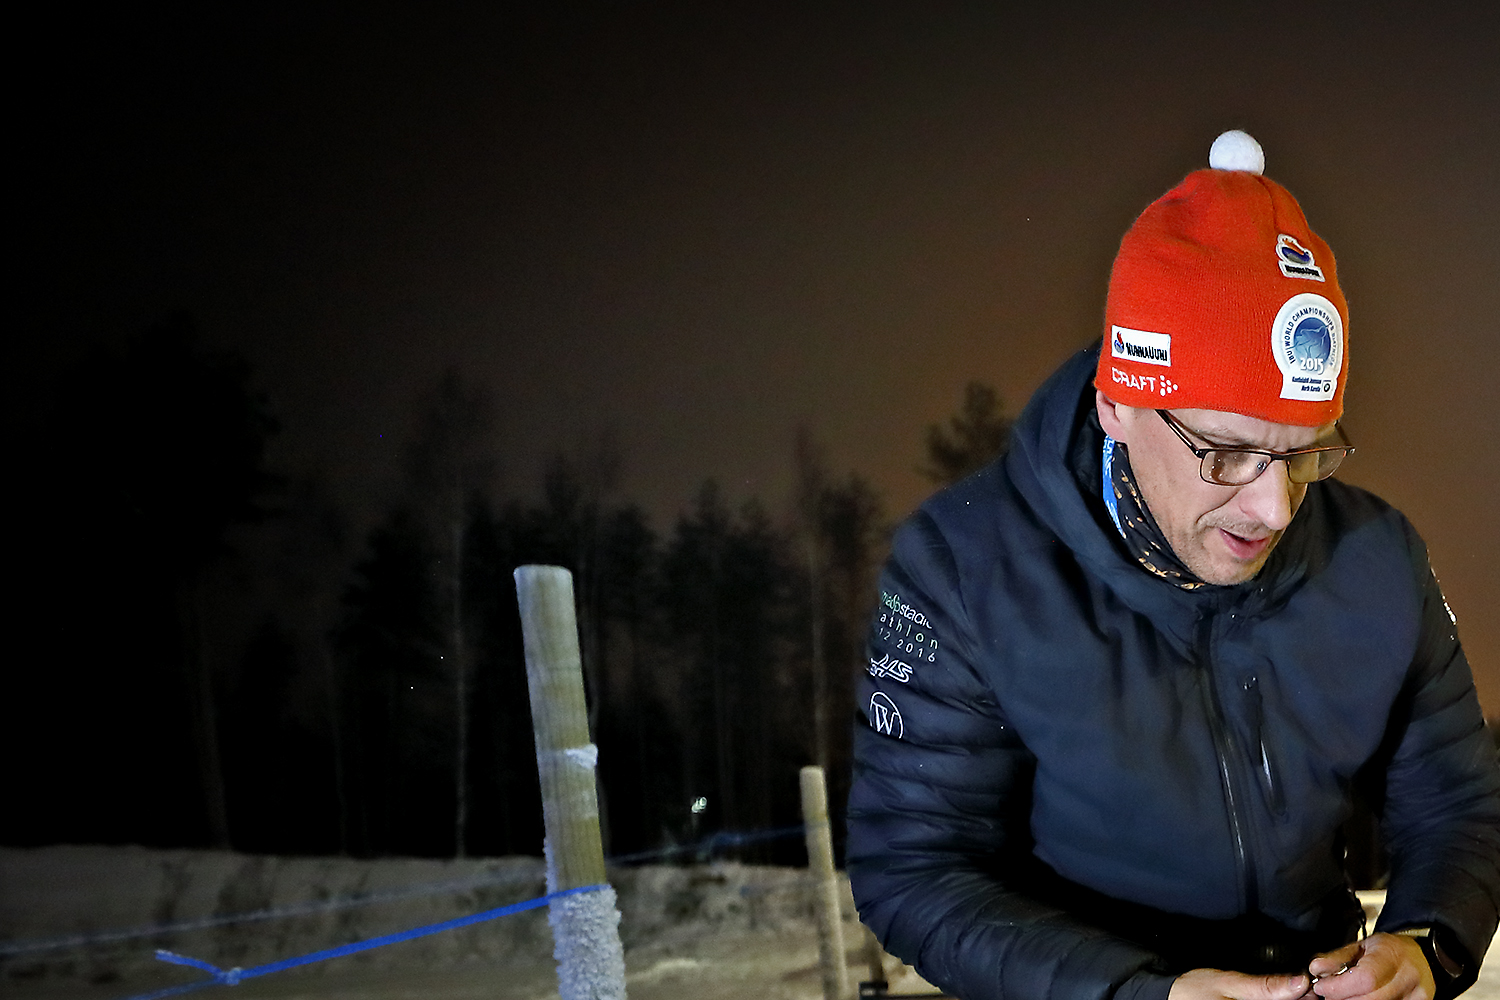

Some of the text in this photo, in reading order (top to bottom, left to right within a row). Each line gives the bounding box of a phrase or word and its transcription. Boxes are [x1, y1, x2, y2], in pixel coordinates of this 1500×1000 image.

[1284, 321, 1294, 347] WORLD
[1292, 307, 1335, 331] CHAMPIONSHIPS
[1301, 357, 1324, 375] 2015
[1111, 367, 1156, 392] CRAFT
